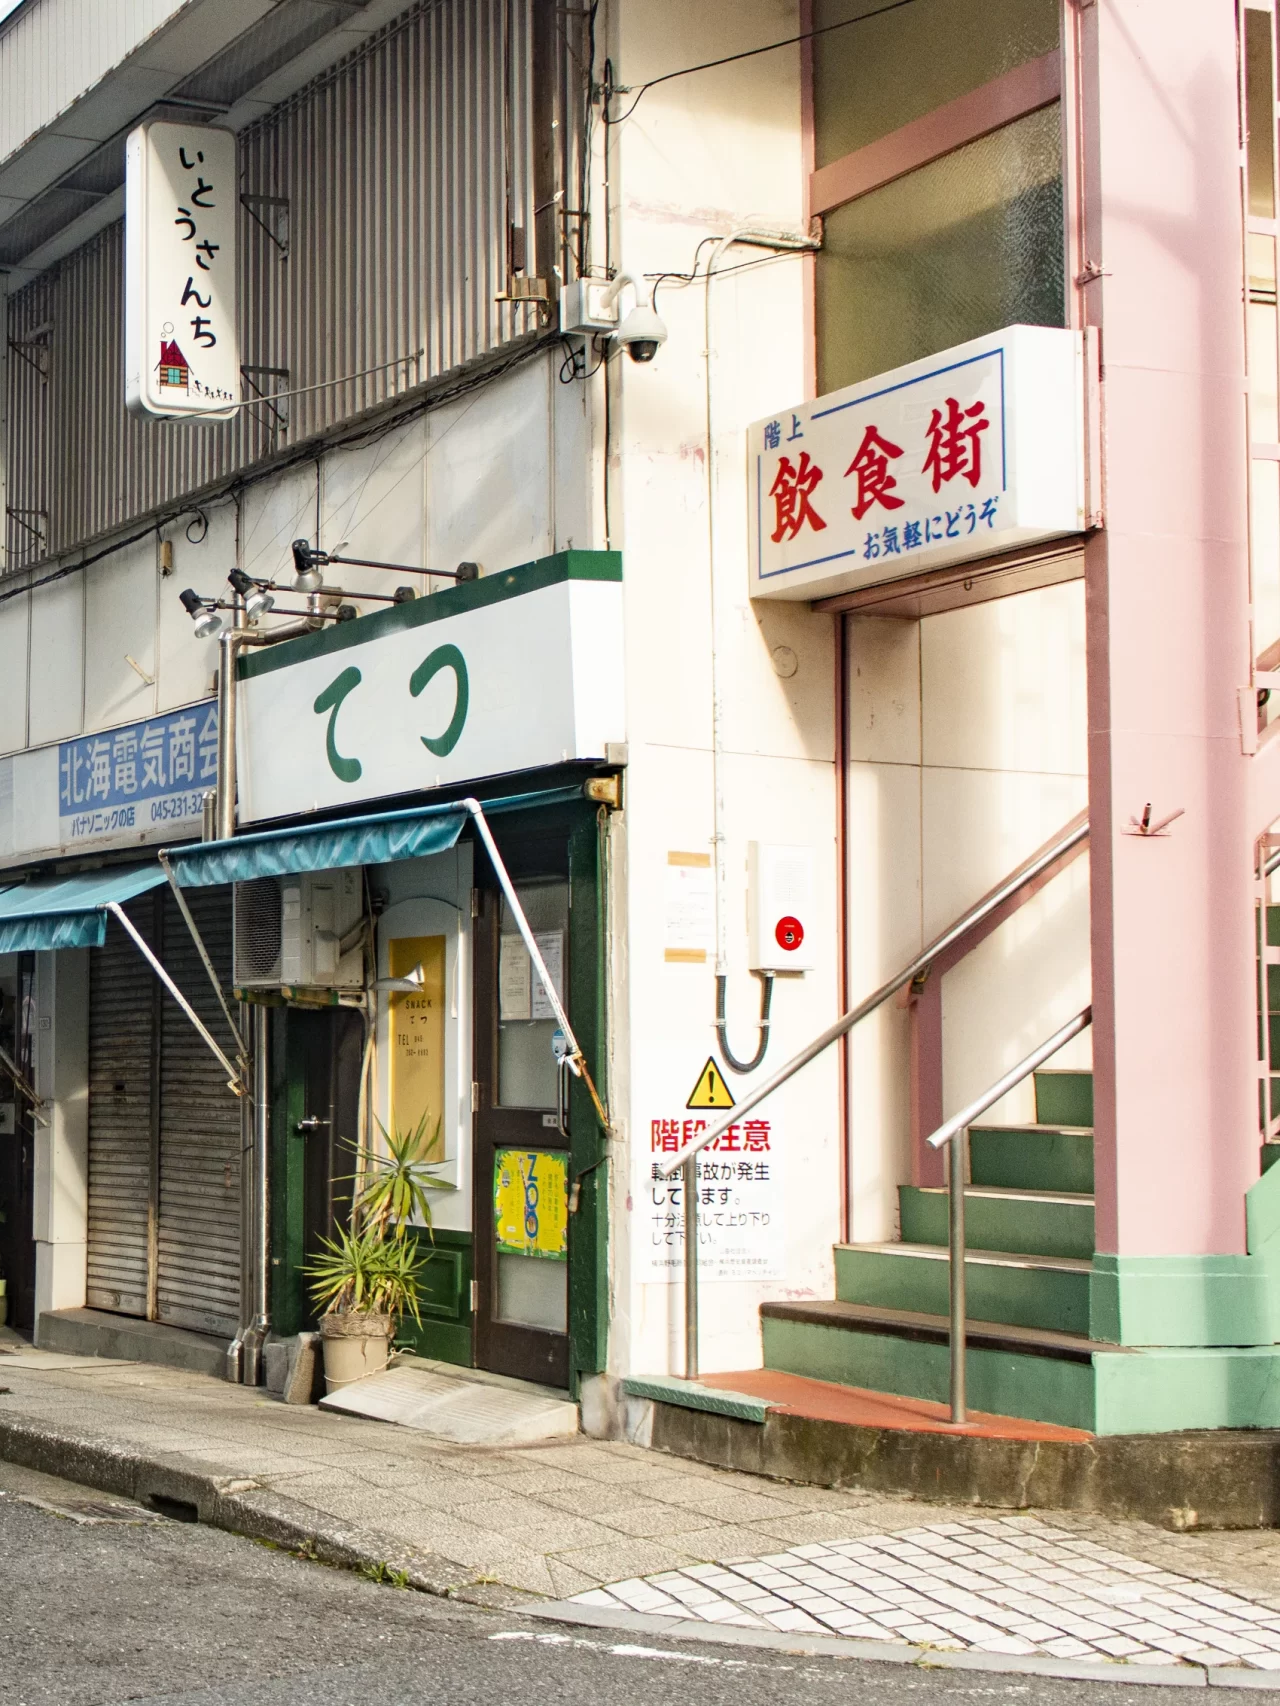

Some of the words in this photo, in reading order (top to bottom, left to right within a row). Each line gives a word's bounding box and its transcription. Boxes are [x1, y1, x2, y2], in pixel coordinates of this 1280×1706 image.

[175, 147, 220, 348] いとうさんち
[763, 414, 804, 451] 階上
[768, 397, 990, 544] 飲食街
[862, 496, 1000, 560] お気軽にどうぞ
[313, 643, 470, 783] てつ
[61, 708, 219, 806] 北海電気商会
[71, 806, 136, 837] パナソニックの店
[151, 795, 203, 822] 045-231-32
[405, 999, 433, 1010] SNACK
[398, 1034, 410, 1046] TEL
[525, 1154, 539, 1239] ZOO
[652, 1231, 718, 1246] して下い。
